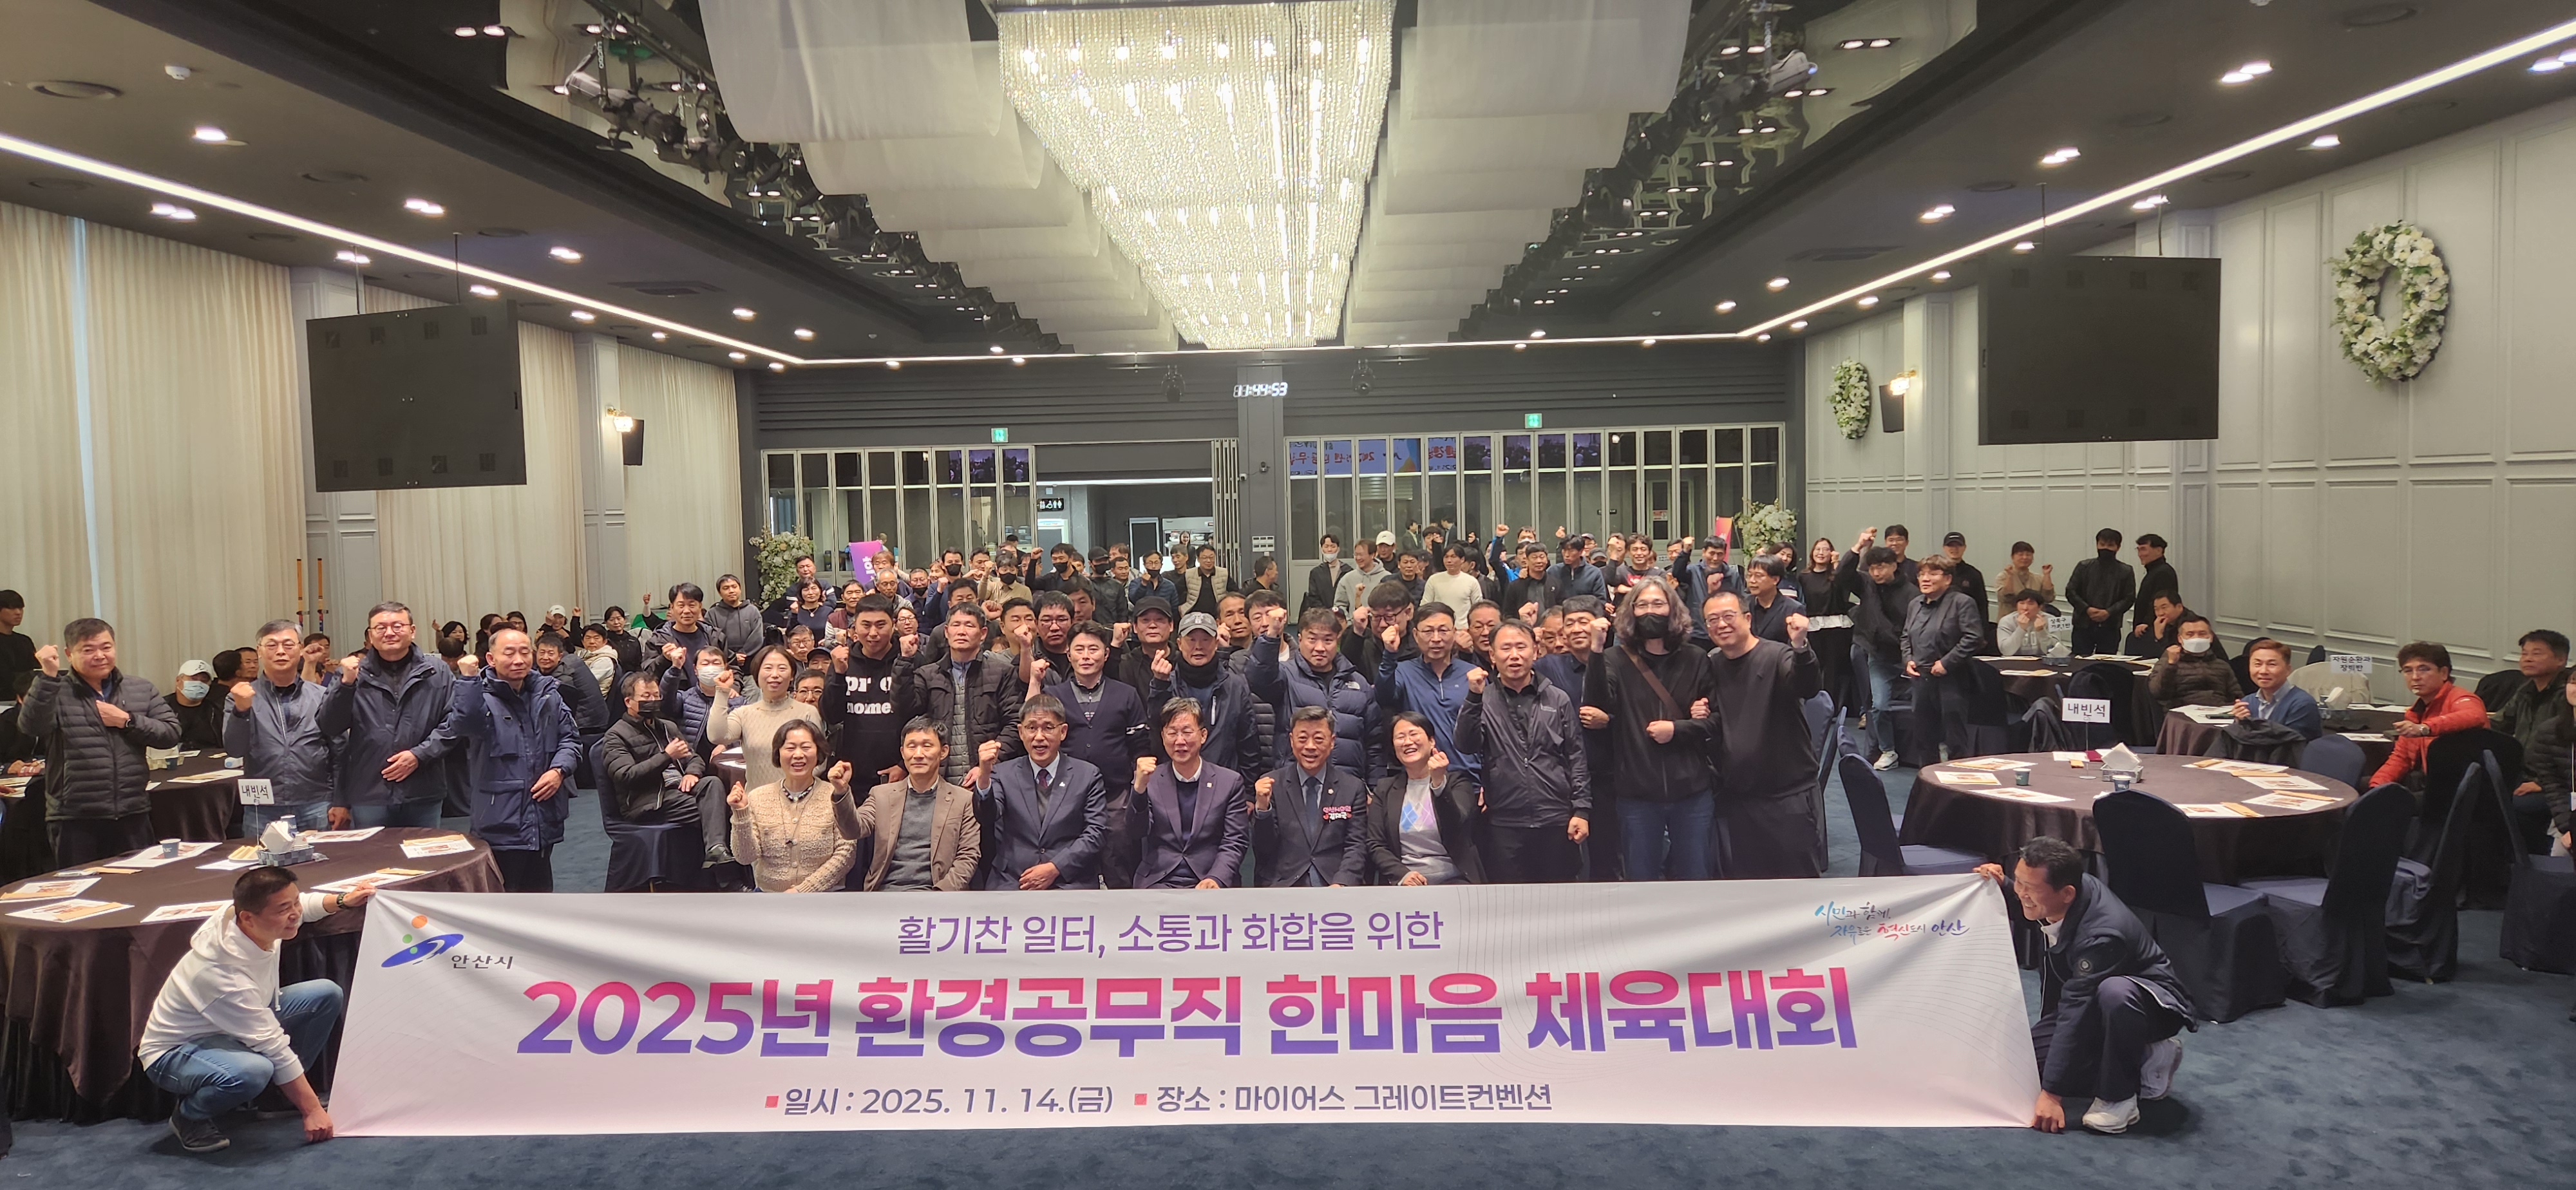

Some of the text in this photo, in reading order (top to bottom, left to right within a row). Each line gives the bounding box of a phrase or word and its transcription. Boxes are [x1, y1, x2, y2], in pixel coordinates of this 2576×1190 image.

[1233, 382, 1288, 397] 11:44:53
[2067, 703, 2105, 717] 내빈석
[241, 784, 269, 800] 내빈석
[1814, 900, 1861, 927] 시민과
[898, 911, 1444, 959] 활기찬 일터, 소통과 화합을 위한
[1830, 919, 1971, 946] 자유로운 혁신도시 안산
[451, 954, 514, 970] 안산시
[516, 967, 1858, 1058] 2025년 환경공무직 한마음 체육대회
[860, 1088, 951, 1114] 2025.
[964, 1088, 1008, 1113] 11.
[1235, 1085, 1346, 1111] 마이어스
[1353, 1083, 1553, 1111] 그레이트컨벤션
